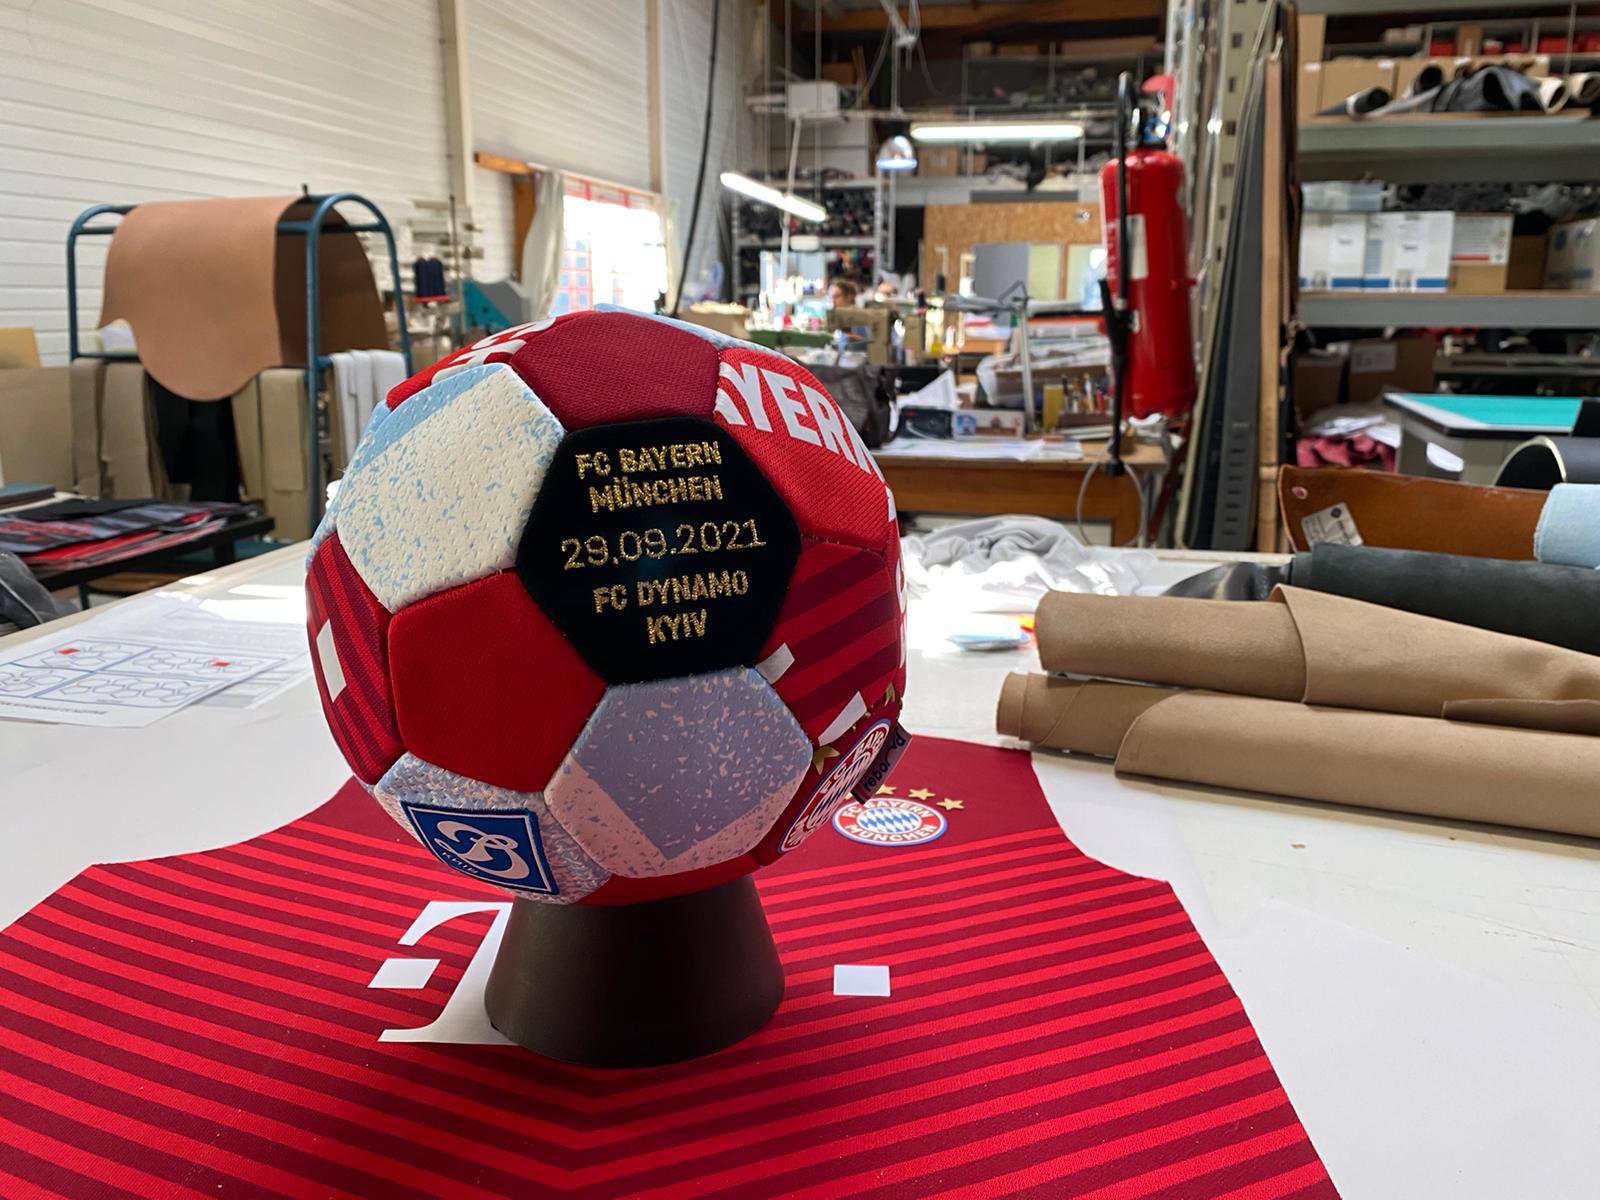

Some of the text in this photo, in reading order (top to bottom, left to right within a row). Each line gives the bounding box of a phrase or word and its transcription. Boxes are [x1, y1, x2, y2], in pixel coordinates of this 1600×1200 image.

[575, 440, 722, 480] FC BAYERN
[588, 474, 723, 513] MÜNCHEN
[561, 518, 767, 571] 29.09.2021
[593, 570, 749, 613] FC DYNAMO
[646, 608, 707, 644] KYIV
